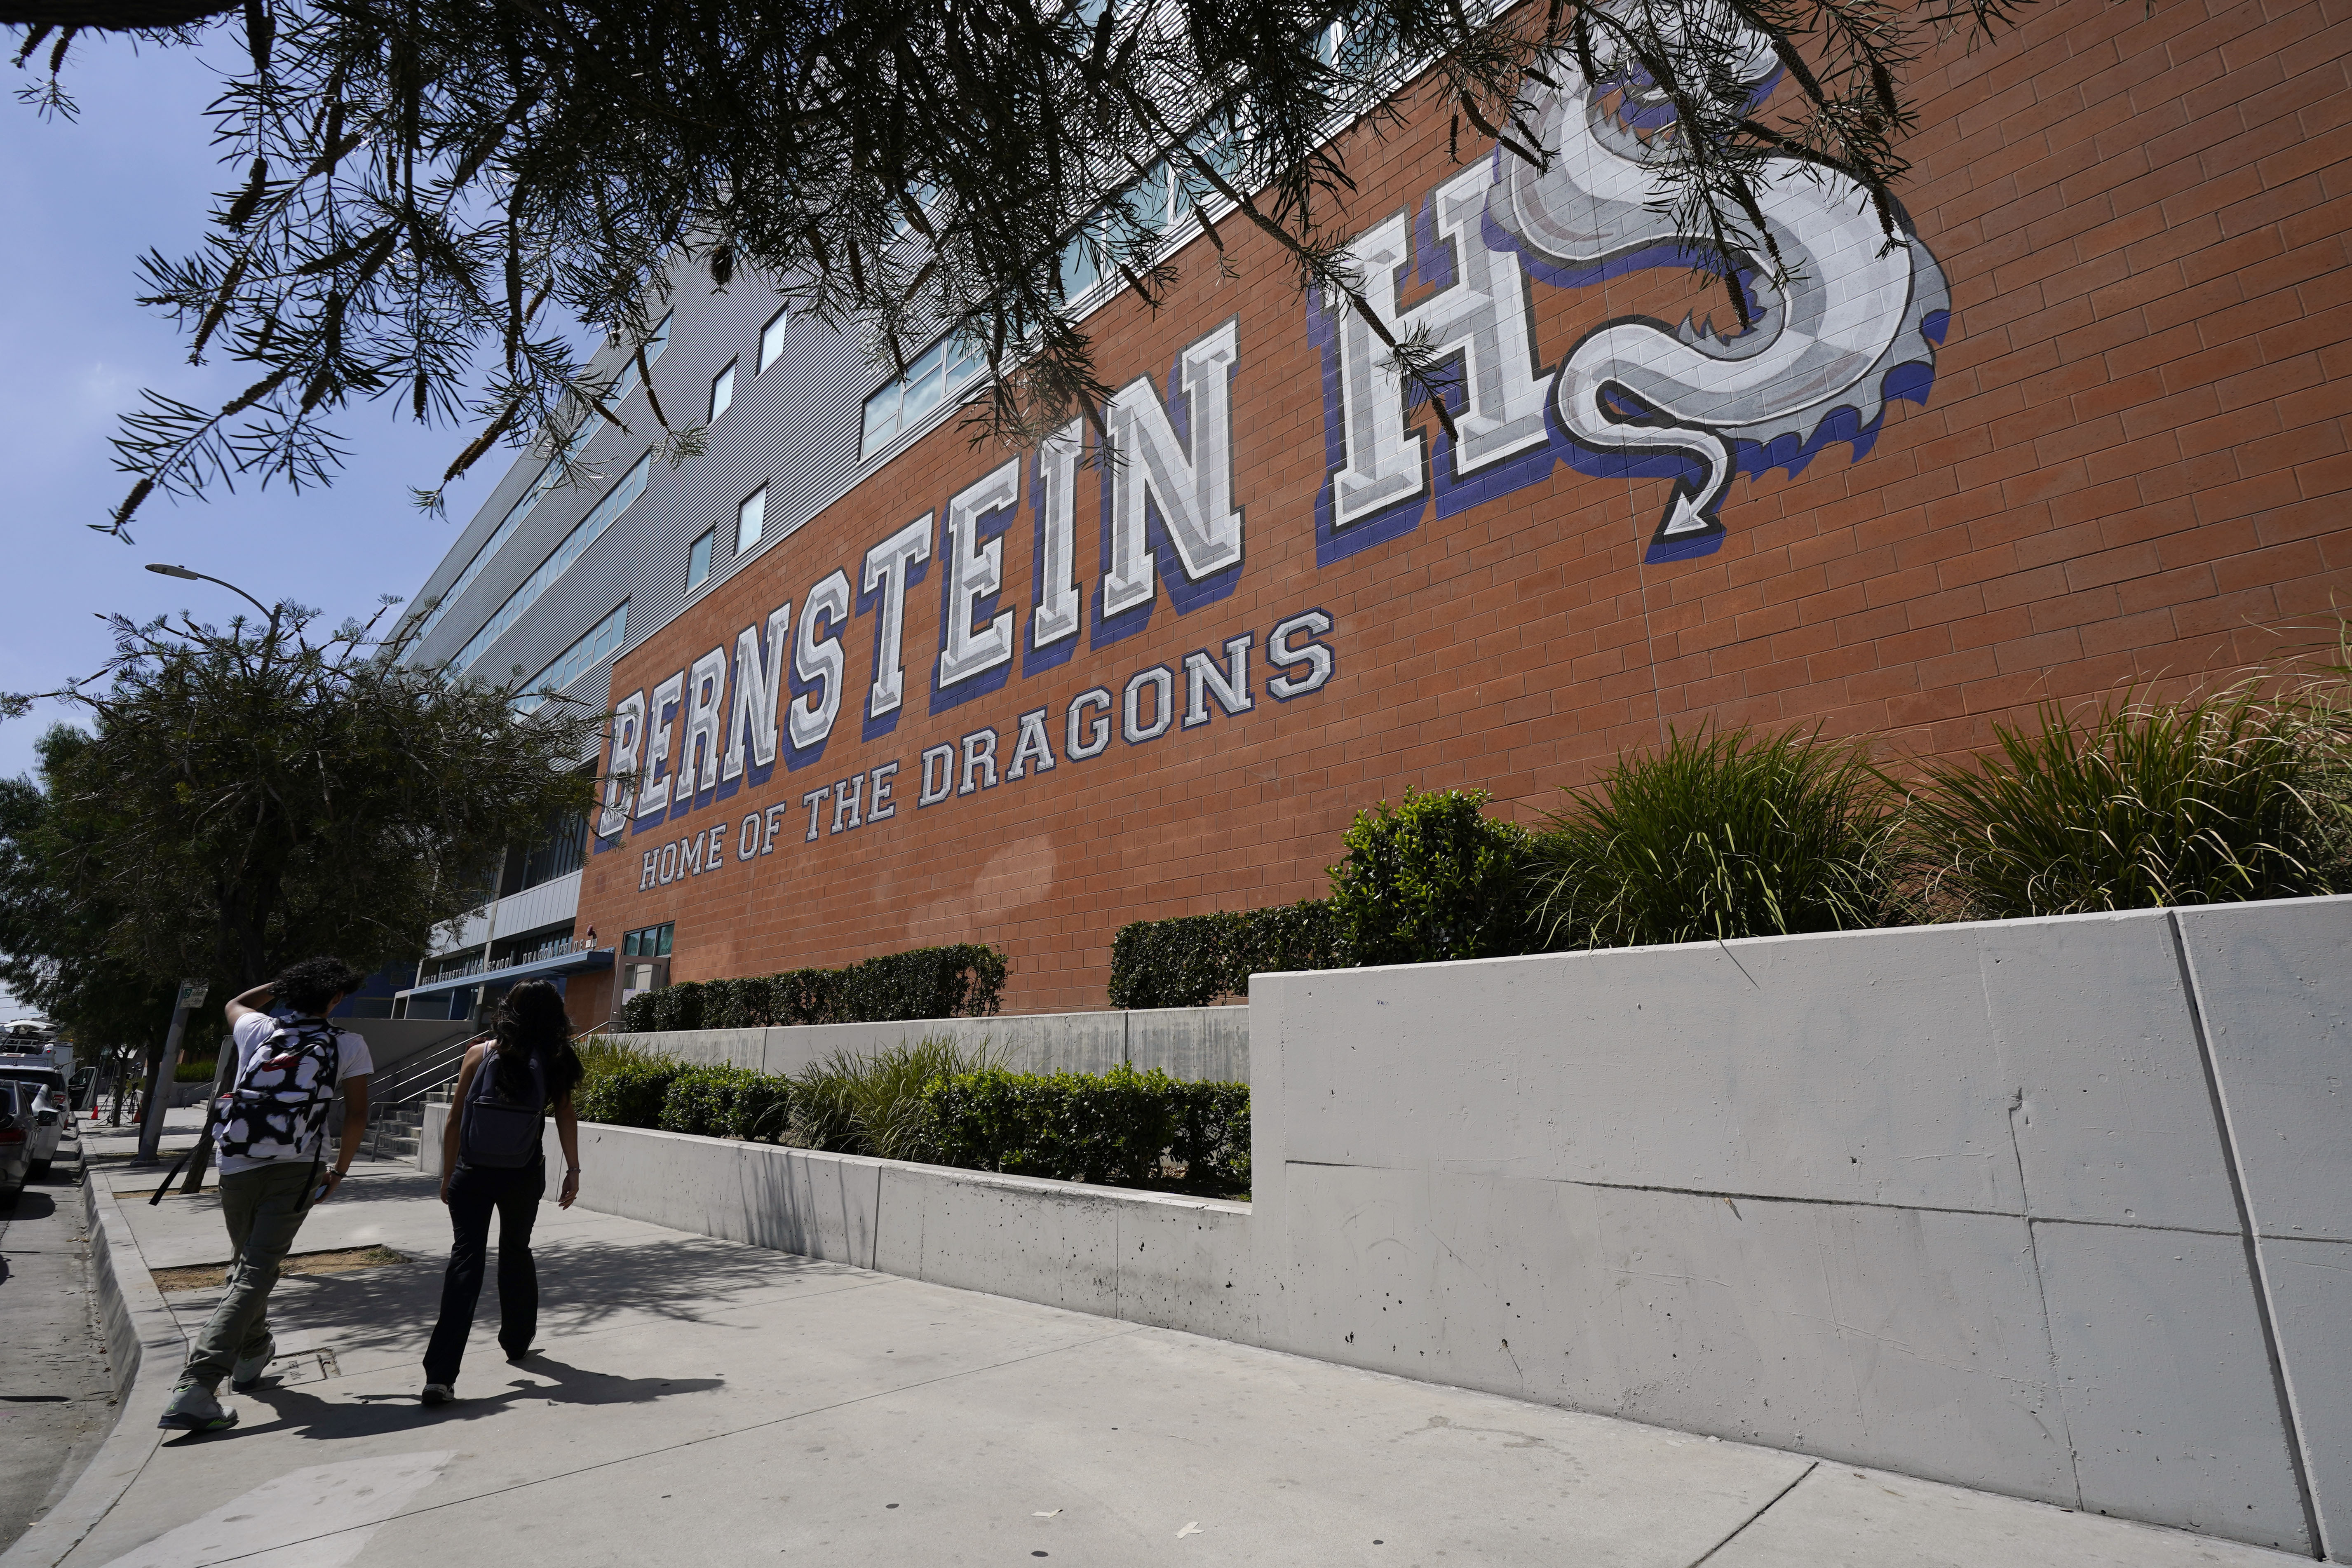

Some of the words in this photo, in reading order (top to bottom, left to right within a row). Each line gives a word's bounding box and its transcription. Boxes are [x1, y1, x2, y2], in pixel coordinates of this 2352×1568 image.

[596, 315, 1245, 843] BERNSTEIN
[638, 824, 727, 892] HOME
[737, 802, 786, 861] OF
[802, 760, 899, 843] THE
[917, 606, 1336, 809] DRAGONS
[422, 974, 437, 986] HELEN
[438, 966, 468, 982] BERNSTEIN
[487, 956, 512, 972] SCHOOL
[522, 946, 554, 965] DRAGON
[558, 938, 584, 956] PRIDE
